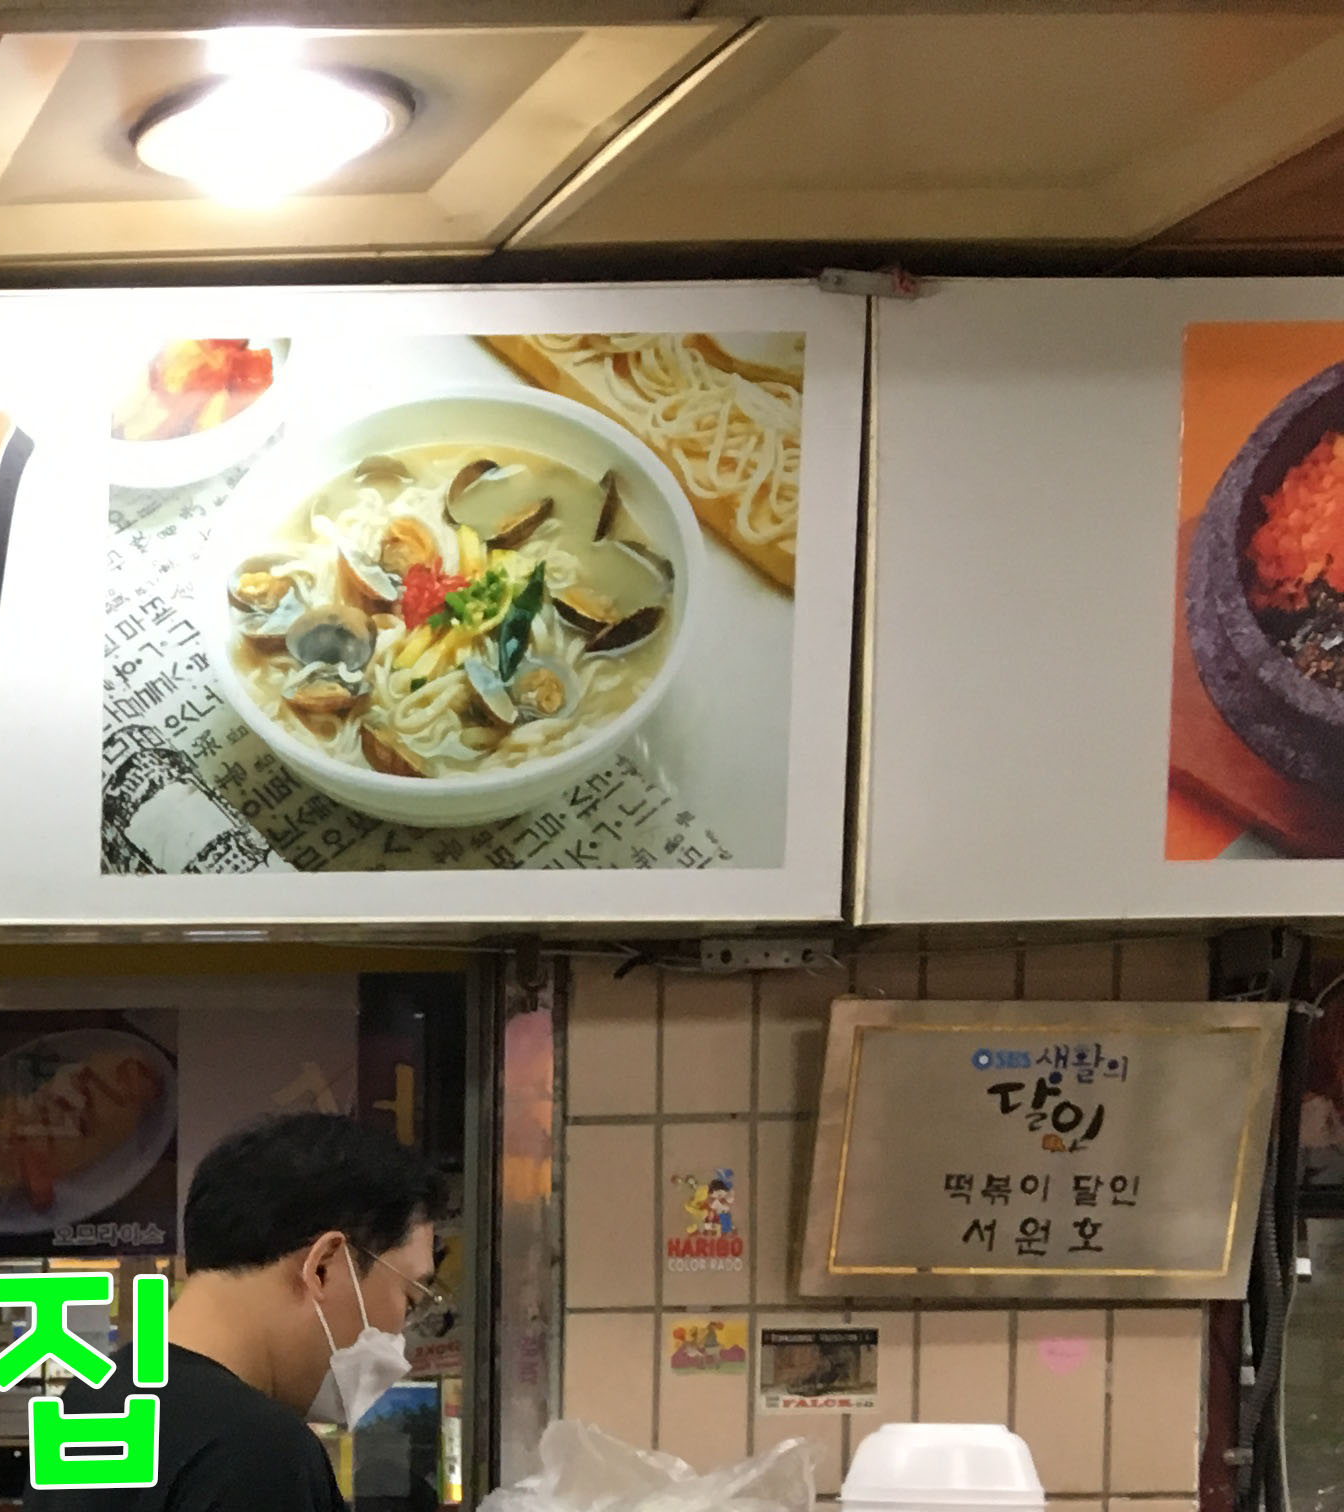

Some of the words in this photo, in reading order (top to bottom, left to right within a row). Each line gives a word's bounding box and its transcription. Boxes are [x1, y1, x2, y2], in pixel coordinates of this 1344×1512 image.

[1036, 1043, 1129, 1085] 생활의
[987, 1077, 1105, 1153] 달인
[944, 1173, 1050, 1206] 떡볶이
[1073, 1175, 1140, 1206] 달인
[52, 1222, 166, 1247] 오므라이스
[667, 1237, 744, 1258] HARIBO
